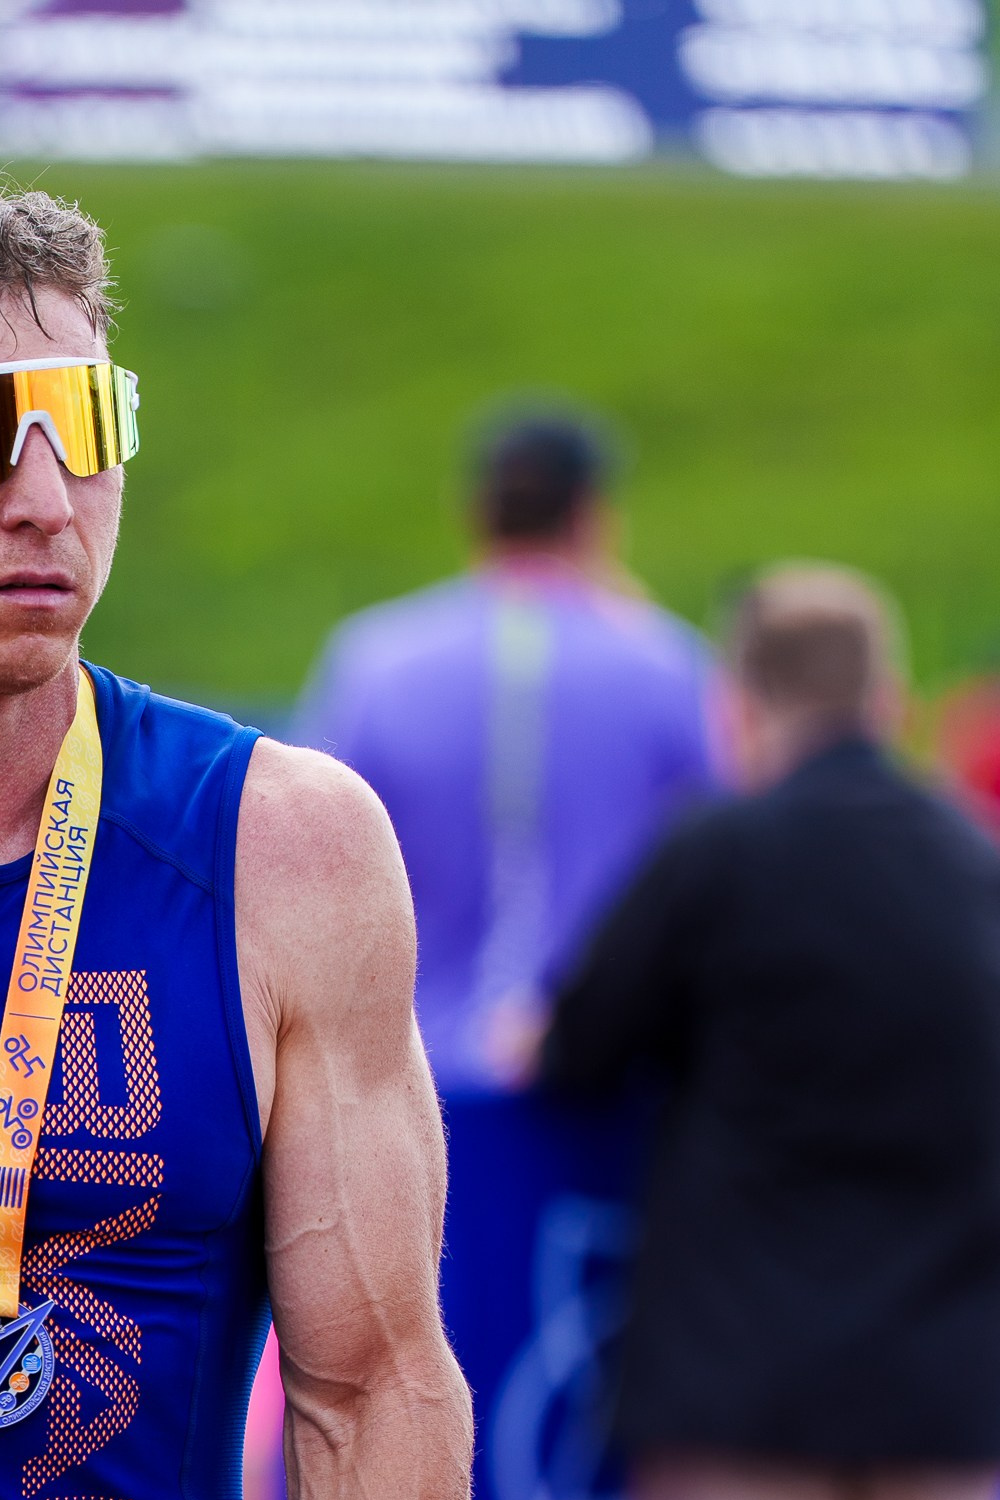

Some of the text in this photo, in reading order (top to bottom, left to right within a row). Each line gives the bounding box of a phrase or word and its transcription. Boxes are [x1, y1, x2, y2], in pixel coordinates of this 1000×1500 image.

[18, 778, 75, 992] ОЛИМПИЙСКАЯ
[40, 826, 88, 997] ДИСТАНЦИЯ
[1, 1331, 54, 1425] ОЛИМПИЙСКАЯ ДИСТАНЦИЯ
